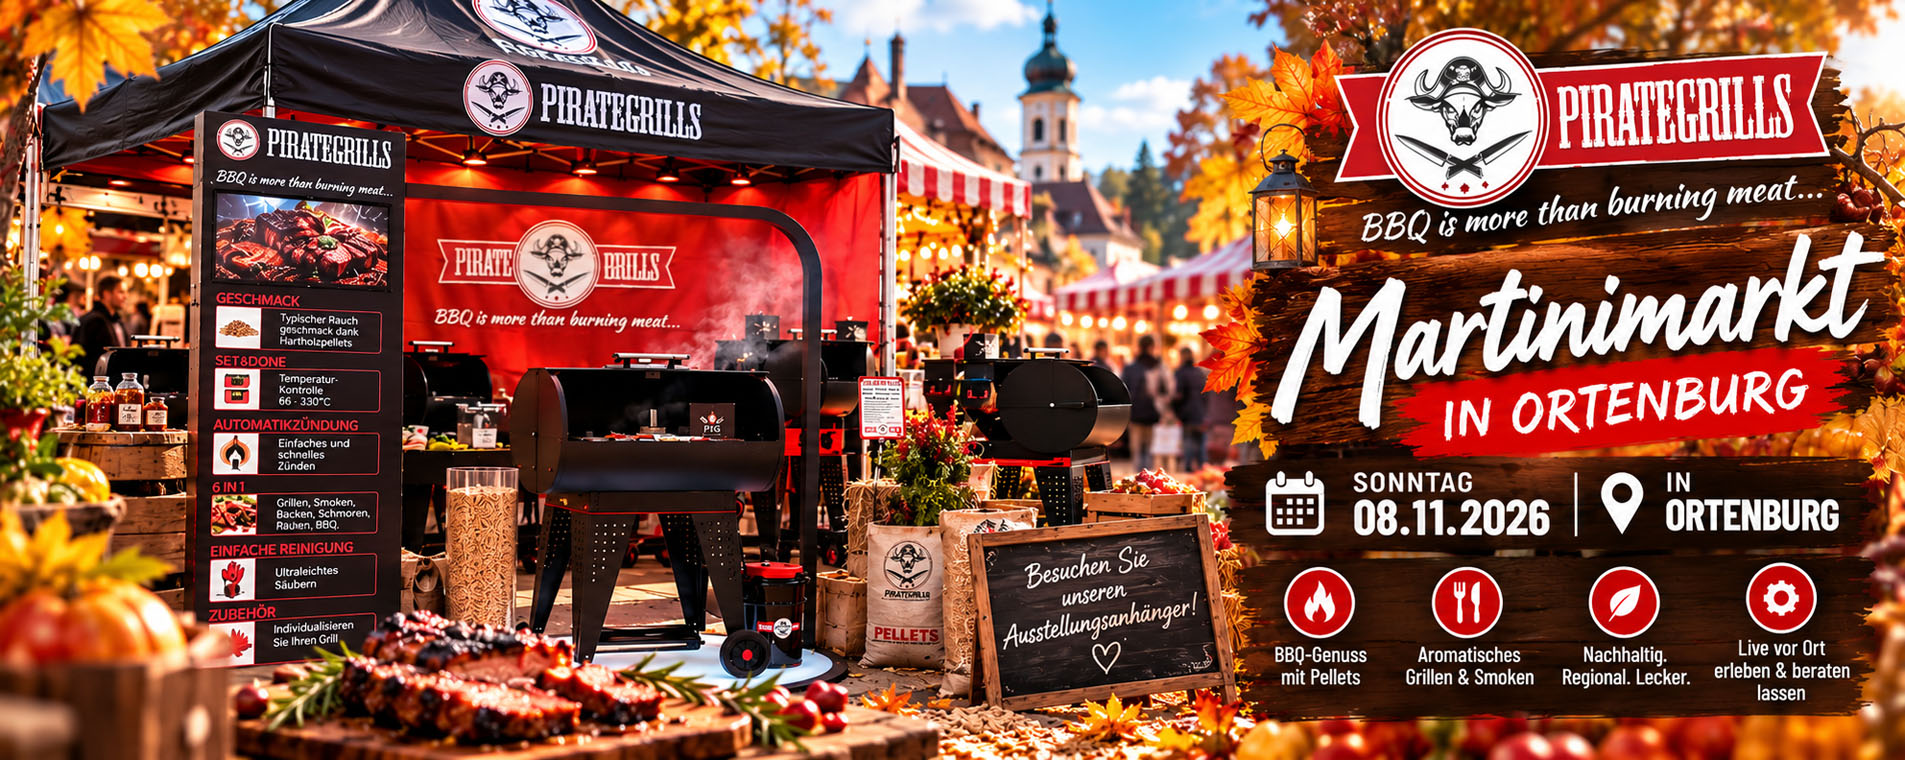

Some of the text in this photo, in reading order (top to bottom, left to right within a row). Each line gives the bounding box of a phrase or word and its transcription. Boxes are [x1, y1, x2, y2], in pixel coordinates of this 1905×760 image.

[540, 83, 702, 141] PIRATEGRILLS
[267, 128, 392, 169] PIRATEGRILLS
[216, 170, 393, 197] BBQ is more than burning meat...
[454, 247, 513, 276] PIRATE
[216, 292, 300, 307] GESCHMACK
[280, 313, 358, 325] Typischer Rauch
[435, 309, 680, 333] BBQ is more than burning meat...
[336, 327, 359, 337] dank
[280, 337, 352, 348] Hartholzpellets
[279, 374, 338, 385] Temperatur-
[279, 386, 323, 395] Kontrolle
[279, 397, 291, 405] 66
[300, 397, 331, 406] 330°C
[213, 417, 359, 431] AUTOMATIKZÜNDUNG
[278, 439, 350, 448] Einfaches und
[278, 450, 324, 459] schnelles
[278, 461, 315, 470] Zünden
[212, 482, 244, 492] 6 IN 1
[277, 498, 355, 508] Grillen, Smoken,
[277, 509, 370, 519] Backen, Schmoren,
[316, 521, 339, 530] BBQ.
[210, 542, 354, 557] EINFACHE REINIGUNG
[275, 566, 338, 577] Ultraleichtes
[1024, 546, 1149, 589] Besuchen Sie
[275, 580, 316, 589] Säubern
[1062, 583, 1127, 606] unseren
[209, 604, 276, 621] ZUBEHÖR
[1003, 591, 1198, 650] Ausstellungsanhänger!
[274, 621, 354, 634] Individualisieren
[273, 634, 338, 647] Sie Ihren Grill
[875, 627, 938, 642] PELLETS
